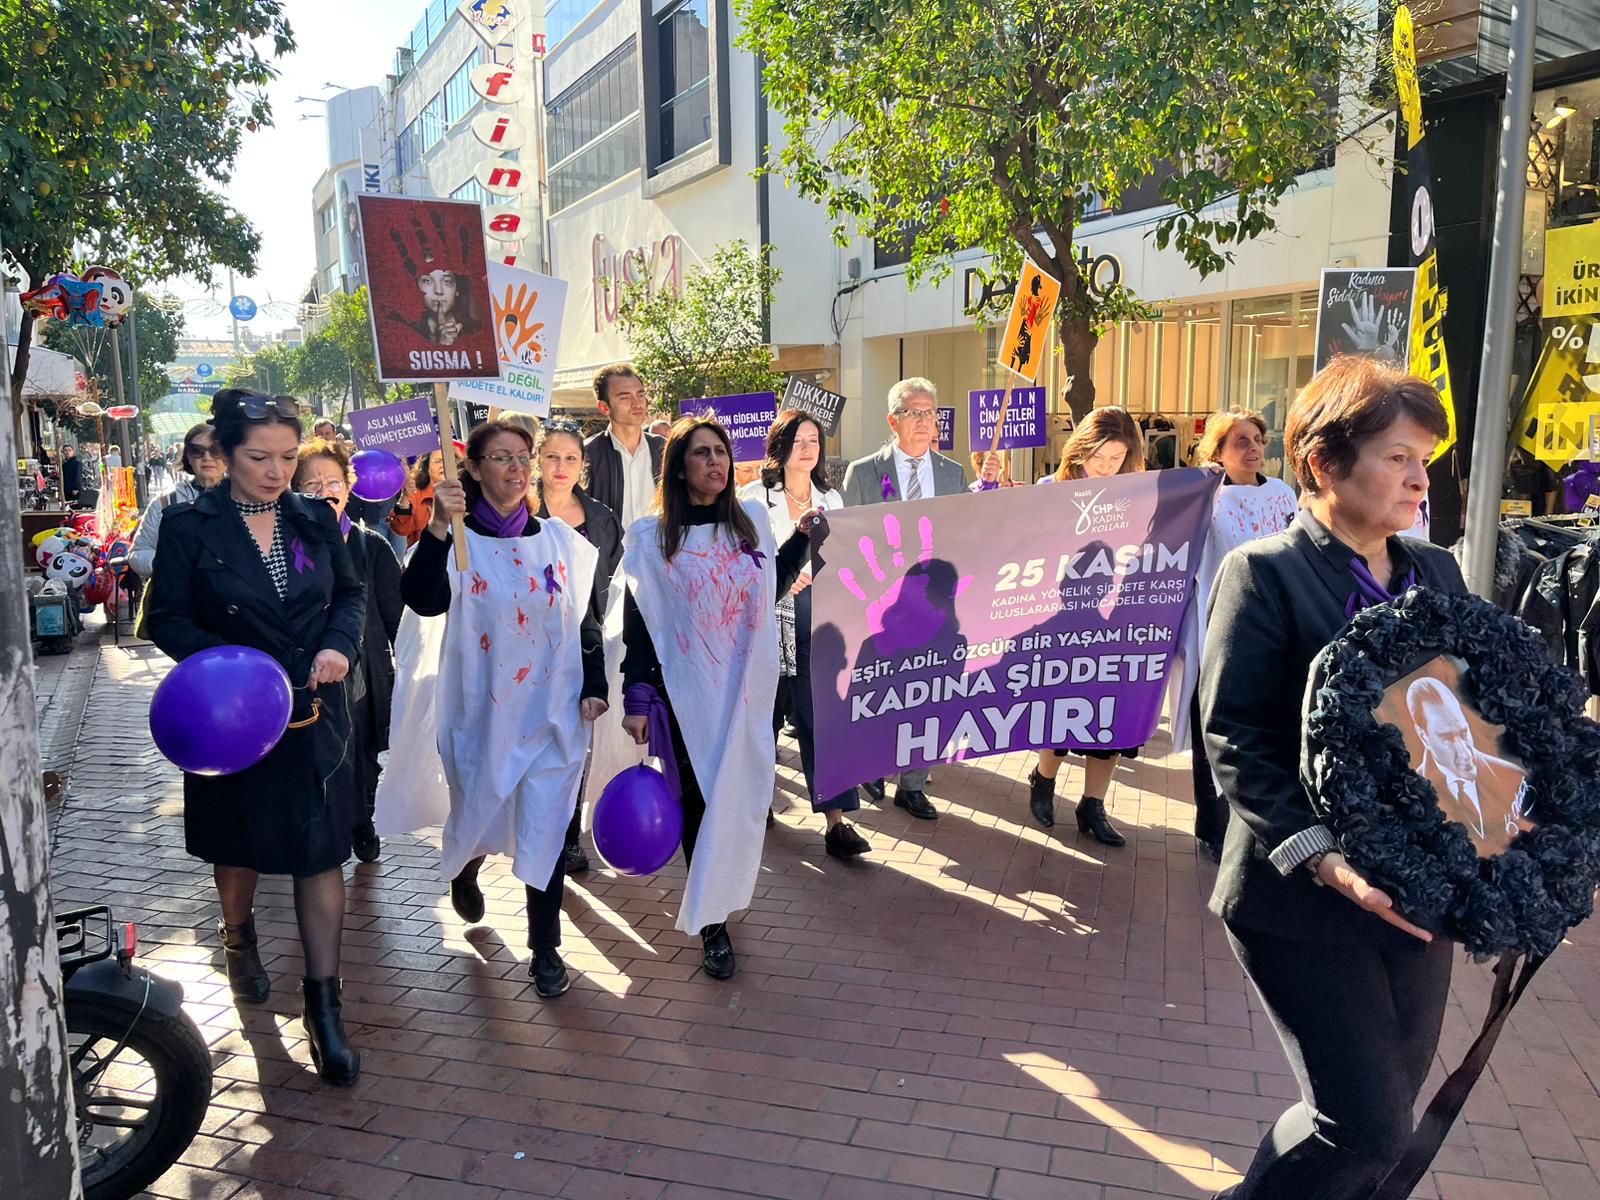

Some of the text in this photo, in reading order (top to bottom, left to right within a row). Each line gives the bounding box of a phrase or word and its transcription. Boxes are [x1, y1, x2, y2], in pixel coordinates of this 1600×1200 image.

[364, 164, 381, 192] IKI
[1348, 271, 1385, 289] Kadına
[409, 350, 471, 371] SUSMA
[475, 350, 483, 369] !
[507, 372, 545, 392] DEĞİL,
[497, 385, 507, 395] EL
[509, 388, 544, 403] KALDIR!
[789, 396, 802, 409] BU
[367, 411, 418, 431] ASLA YALNIZ
[474, 409, 488, 419] HES
[733, 411, 775, 425] GİDENLERE
[979, 405, 1036, 424] CİNAETLERİ
[360, 422, 432, 448] YÜRÜMEYECEKSİN
[1093, 503, 1113, 515] CHP
[1093, 513, 1124, 524] KADIN
[1091, 521, 1129, 534] KOLLARI
[995, 541, 1190, 592] 25 KASIM
[992, 579, 1186, 608] KADINA YÖNELİK ŞİDDETE KARŞI
[990, 592, 1185, 621] ULUSLARARASI MÜCADELE GÜNÜ
[851, 622, 1173, 685] EŞİT, ADİL, ÖZGÜR BİR YAŞAM İÇİN;
[850, 652, 1169, 723] KADINA ŞİDDETE
[894, 695, 1117, 768] HAYIR!
